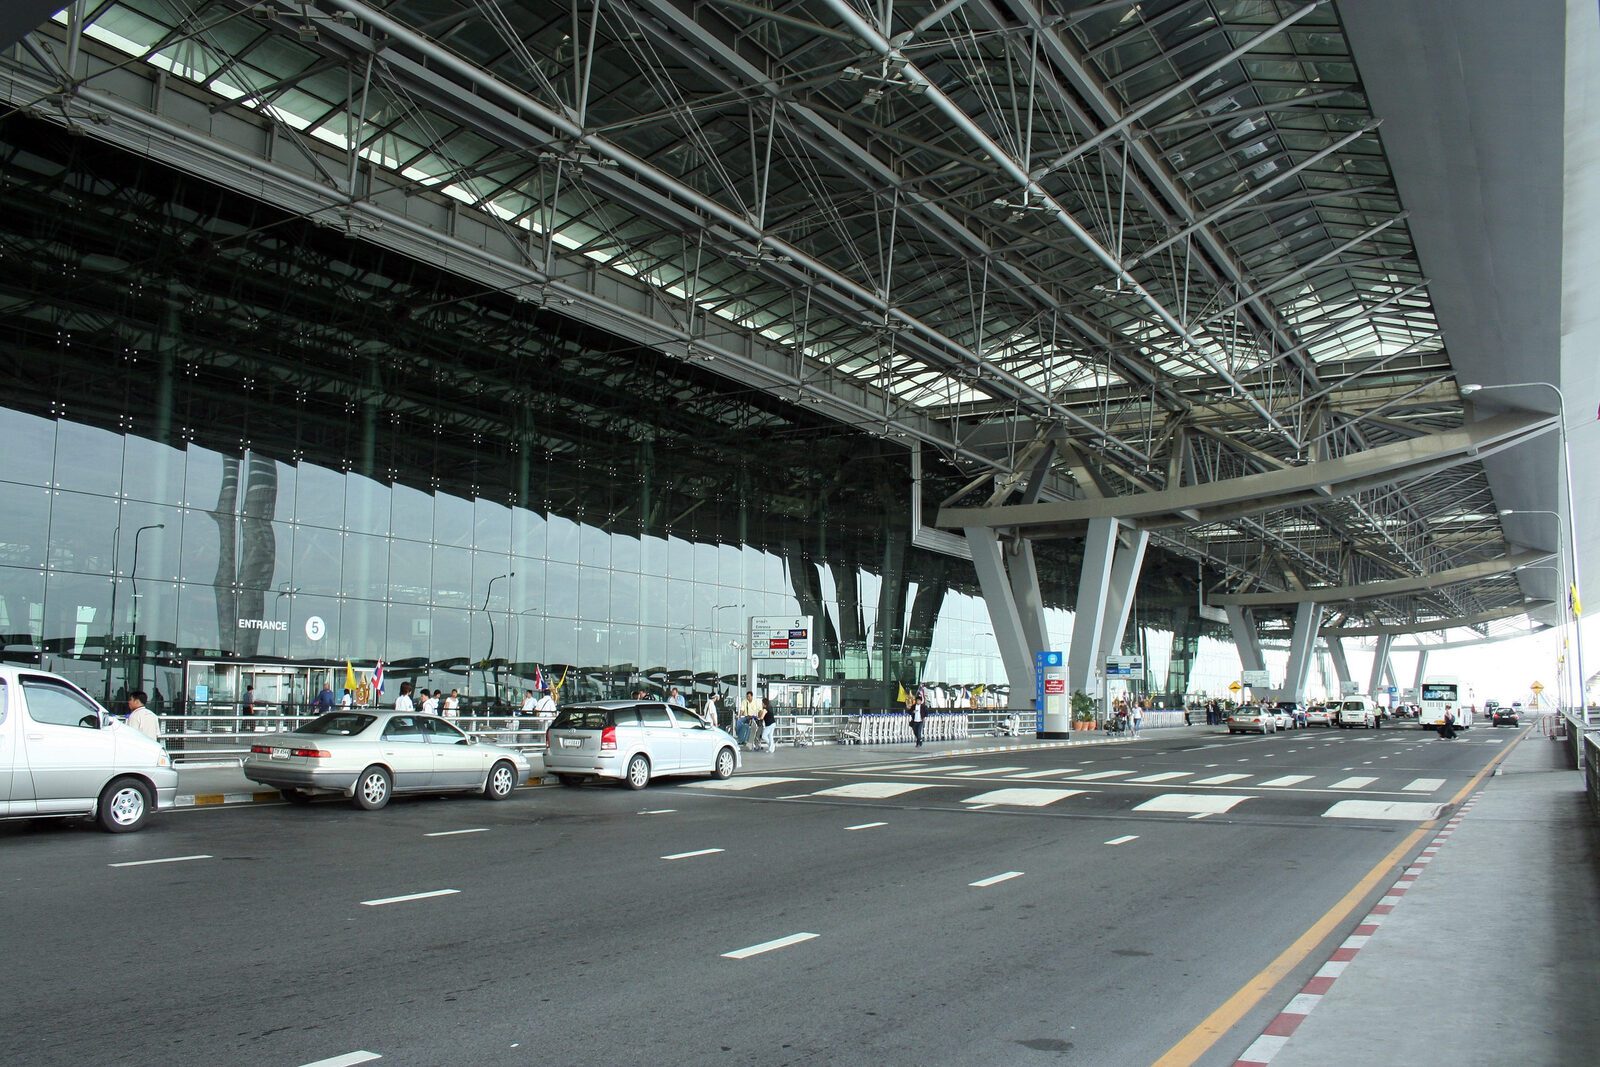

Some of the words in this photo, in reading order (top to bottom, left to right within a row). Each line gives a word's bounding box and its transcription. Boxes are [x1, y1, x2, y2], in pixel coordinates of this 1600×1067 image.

[238, 618, 287, 631] ENTRANCE
[311, 621, 319, 634] 5
[795, 619, 800, 628] 5
